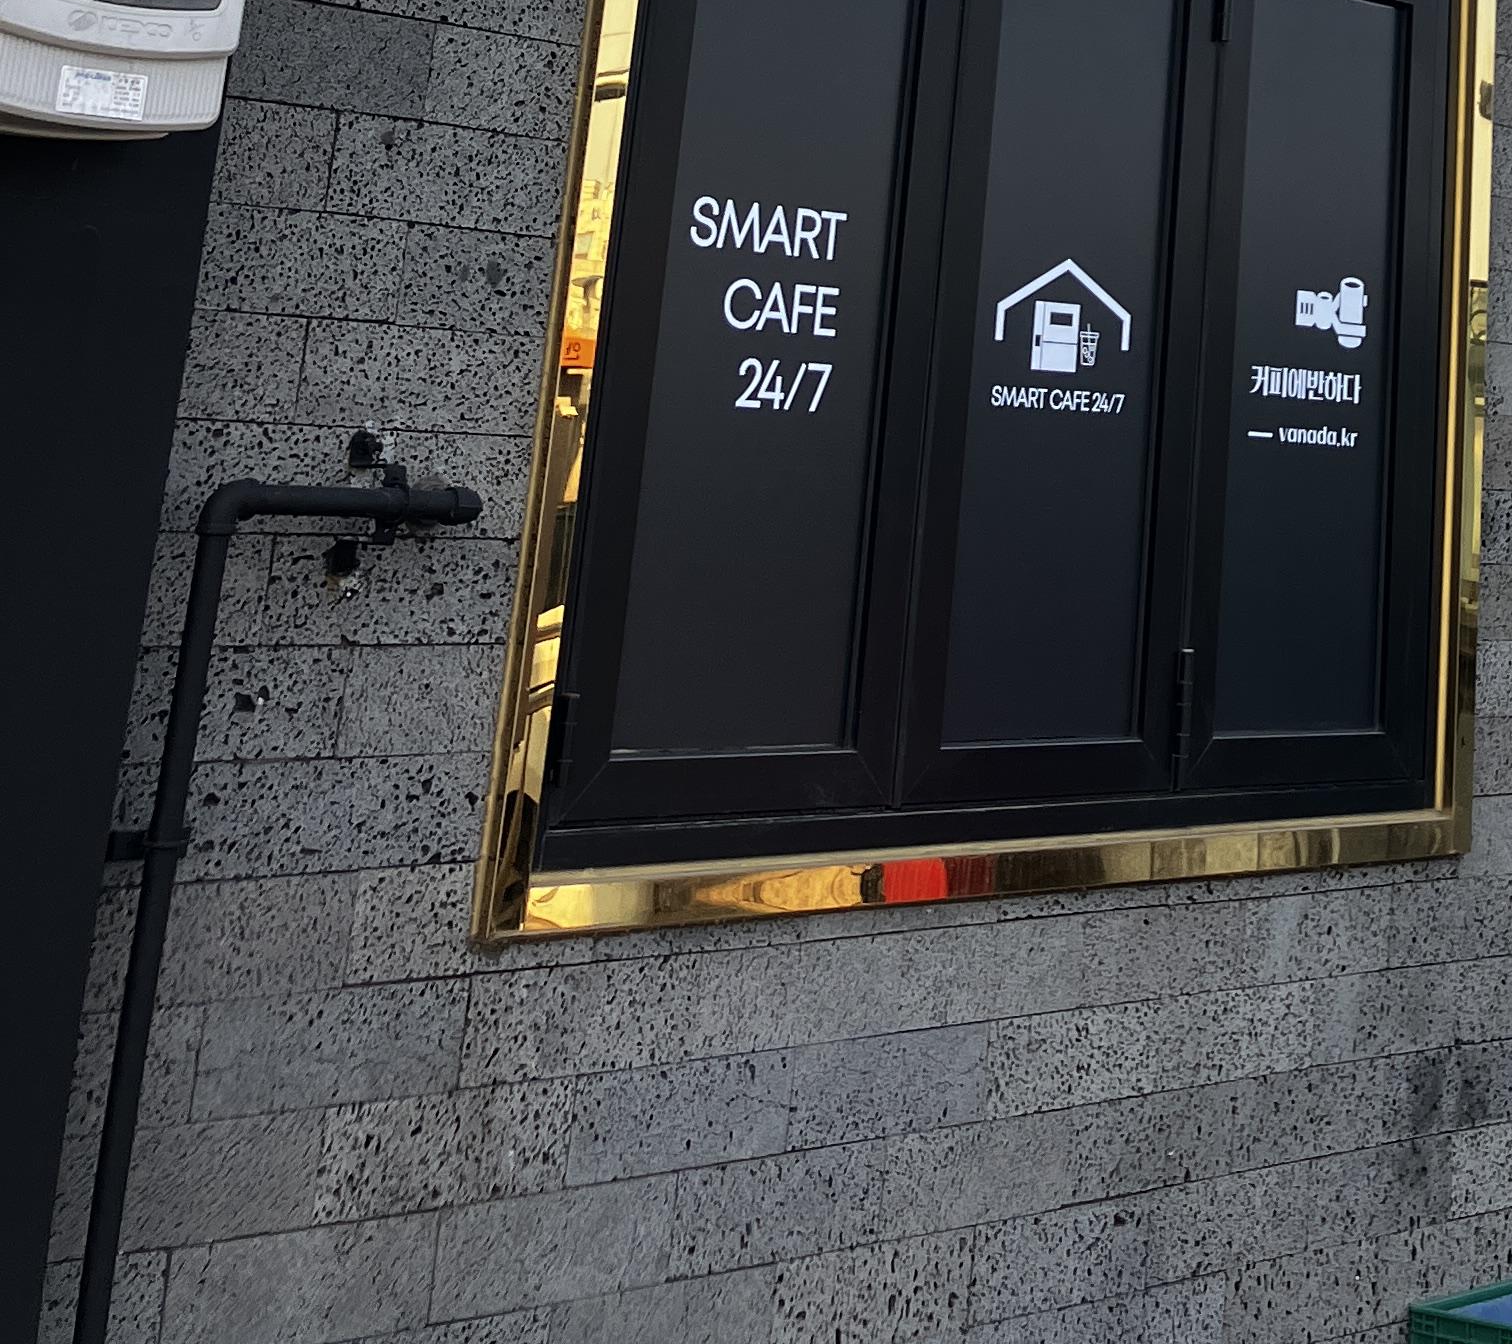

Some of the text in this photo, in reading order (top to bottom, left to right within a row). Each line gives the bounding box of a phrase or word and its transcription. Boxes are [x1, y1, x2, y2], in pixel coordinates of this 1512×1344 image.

[690, 196, 847, 260] SMART
[724, 278, 840, 337] CAFE
[735, 358, 833, 412] 24/7
[990, 384, 1125, 414] SMART CAFE 24/7
[1250, 365, 1362, 404] 커피에반하다
[1279, 426, 1358, 448] vanada.kr
